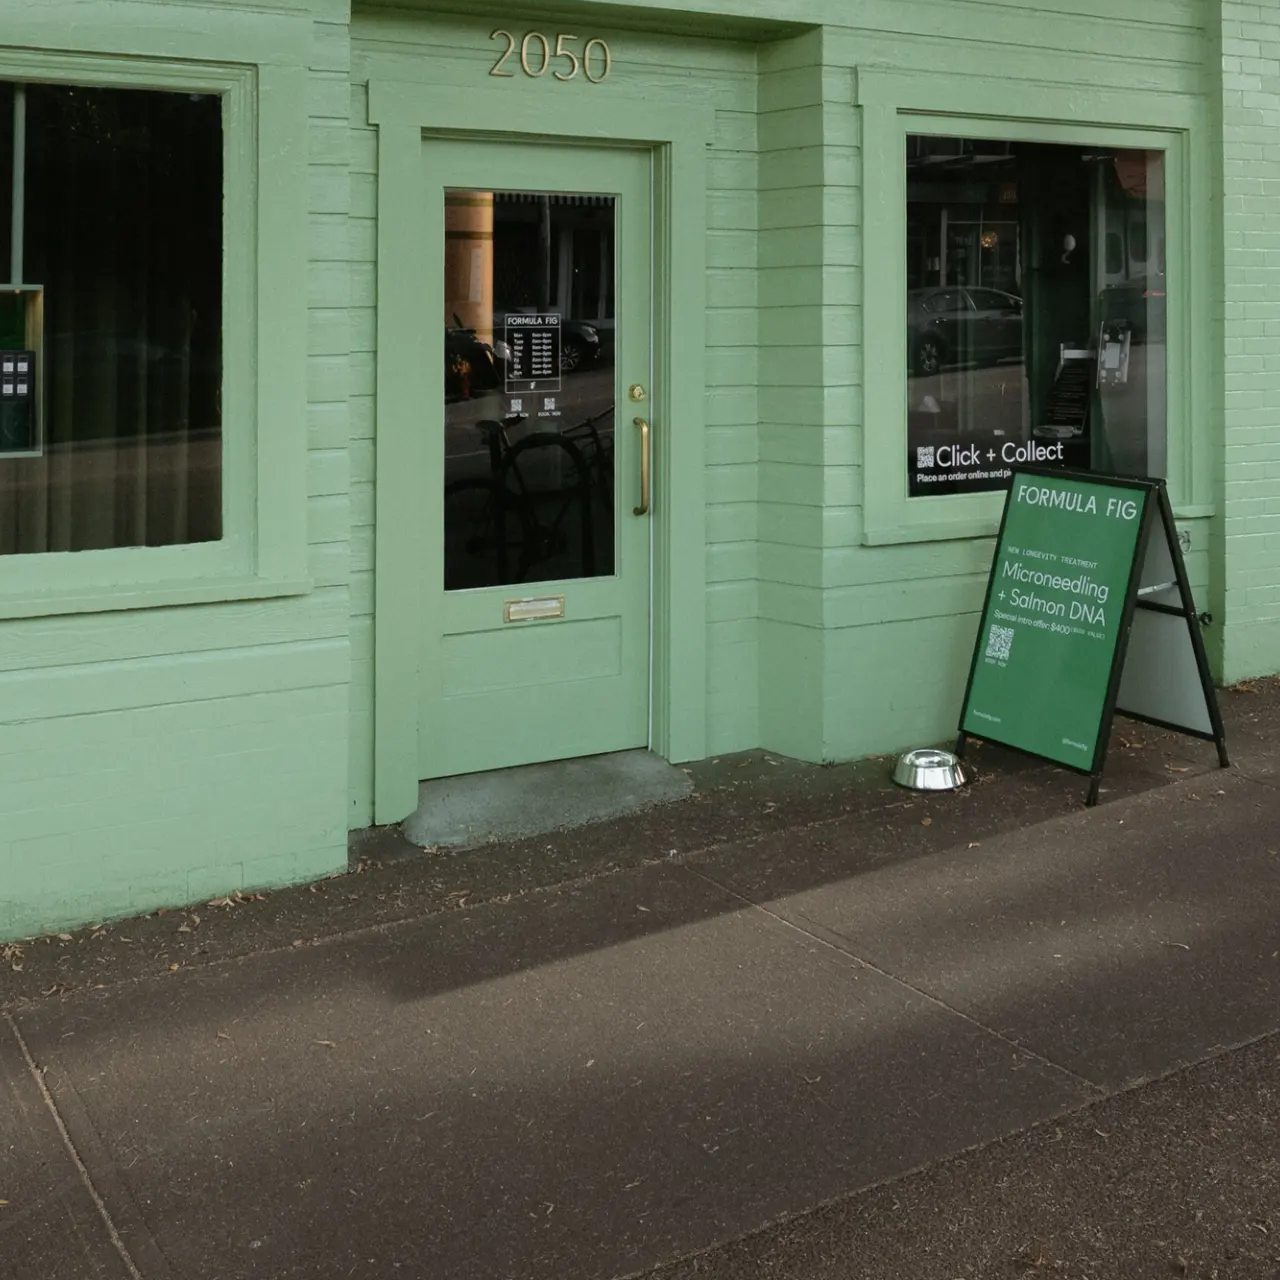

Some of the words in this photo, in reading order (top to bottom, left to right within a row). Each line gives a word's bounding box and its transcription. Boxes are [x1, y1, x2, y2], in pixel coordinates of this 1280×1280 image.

[488, 29, 612, 84] 2050
[508, 317, 542, 325] FORMULA
[545, 317, 558, 325] FIG
[936, 443, 980, 467] Click
[986, 448, 996, 462] +
[1001, 440, 1064, 463] Collect
[916, 472, 937, 483] Place
[938, 474, 948, 482] an
[948, 471, 968, 481] order
[968, 470, 989, 480] online
[989, 469, 1003, 478] and
[1017, 485, 1097, 515] FORMULA
[1106, 498, 1137, 520] FIG
[1022, 548, 1057, 561] LONGEVITY
[1060, 556, 1098, 569] TREATMENT
[1002, 560, 1109, 604] Microneedling
[998, 590, 1006, 600] +
[1009, 588, 1066, 617] Salmon
[1069, 601, 1106, 627] DNA
[993, 609, 1017, 622] Special
[1017, 614, 1032, 626] intro
[1032, 618, 1050, 630] offer:
[1050, 621, 1071, 635] $400
